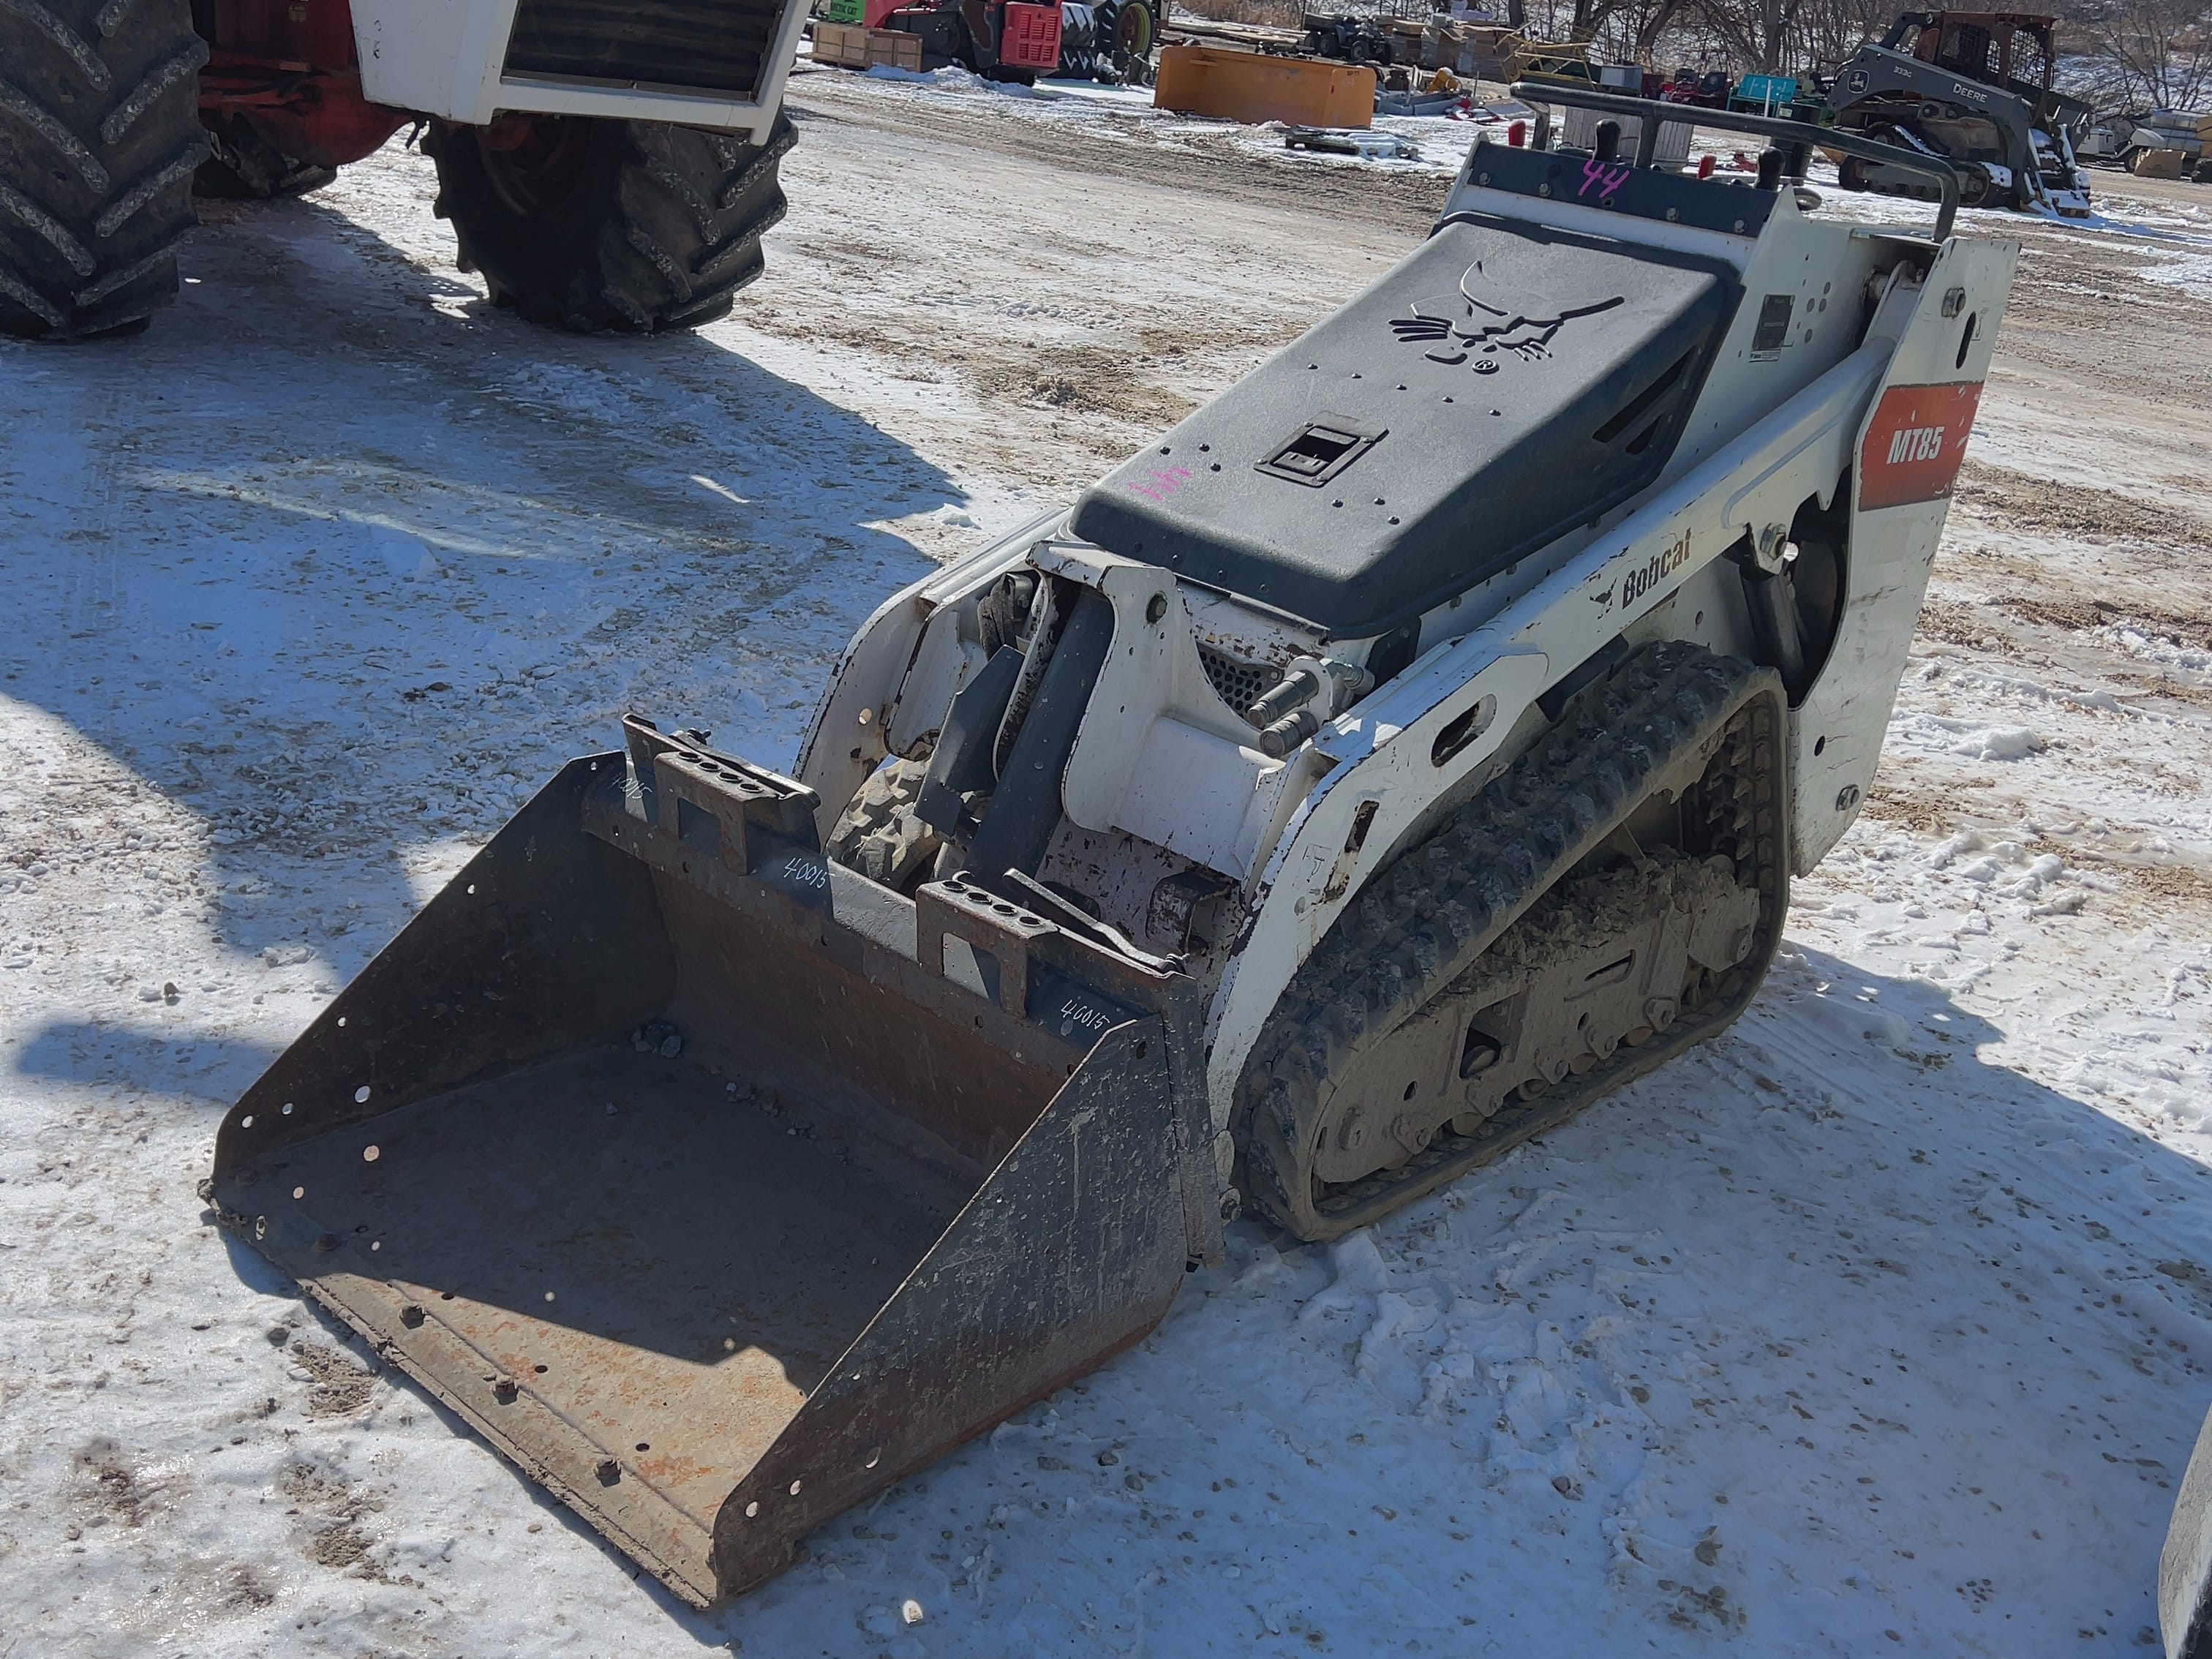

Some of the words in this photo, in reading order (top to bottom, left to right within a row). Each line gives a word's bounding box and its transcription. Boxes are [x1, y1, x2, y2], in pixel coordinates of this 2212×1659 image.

[1952, 83, 1987, 103] DEERE
[1578, 159, 1630, 198] 44
[1886, 426, 1946, 464] MT85
[1622, 527, 1692, 610] Bobcat
[783, 857, 835, 889] 40015
